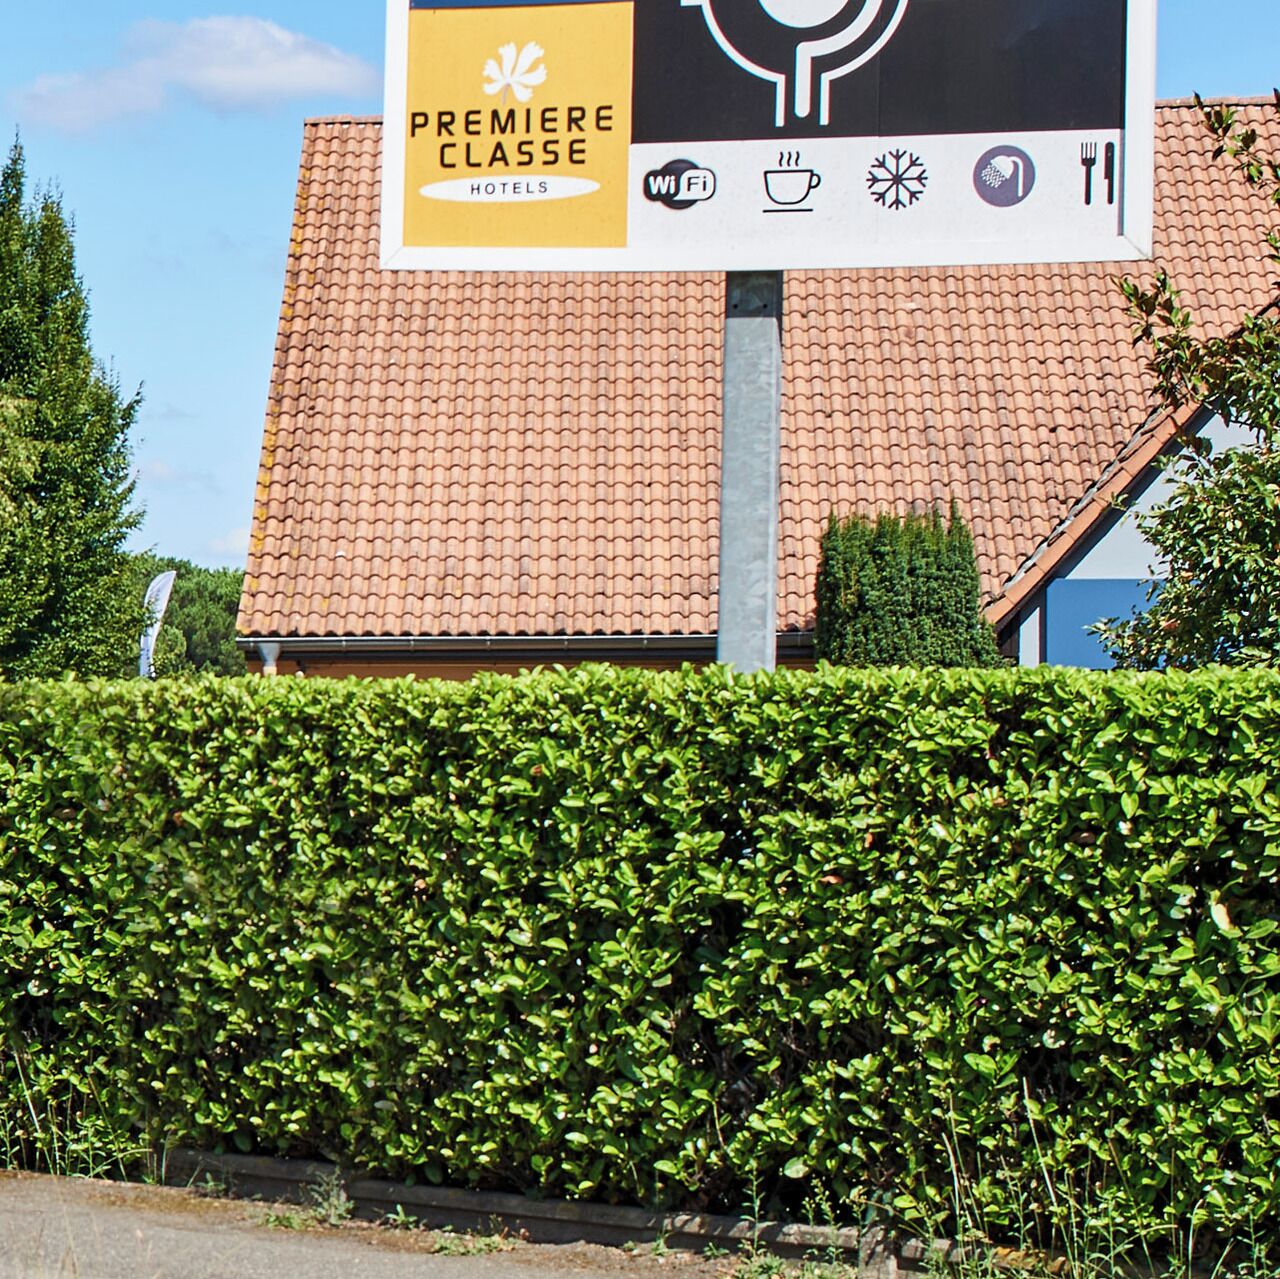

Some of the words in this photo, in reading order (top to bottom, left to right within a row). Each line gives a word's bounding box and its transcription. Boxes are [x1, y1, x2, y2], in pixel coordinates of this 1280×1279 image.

[410, 105, 613, 137] PREMIERE
[439, 138, 586, 168] CLASSE
[470, 181, 548, 195] HOTELS
